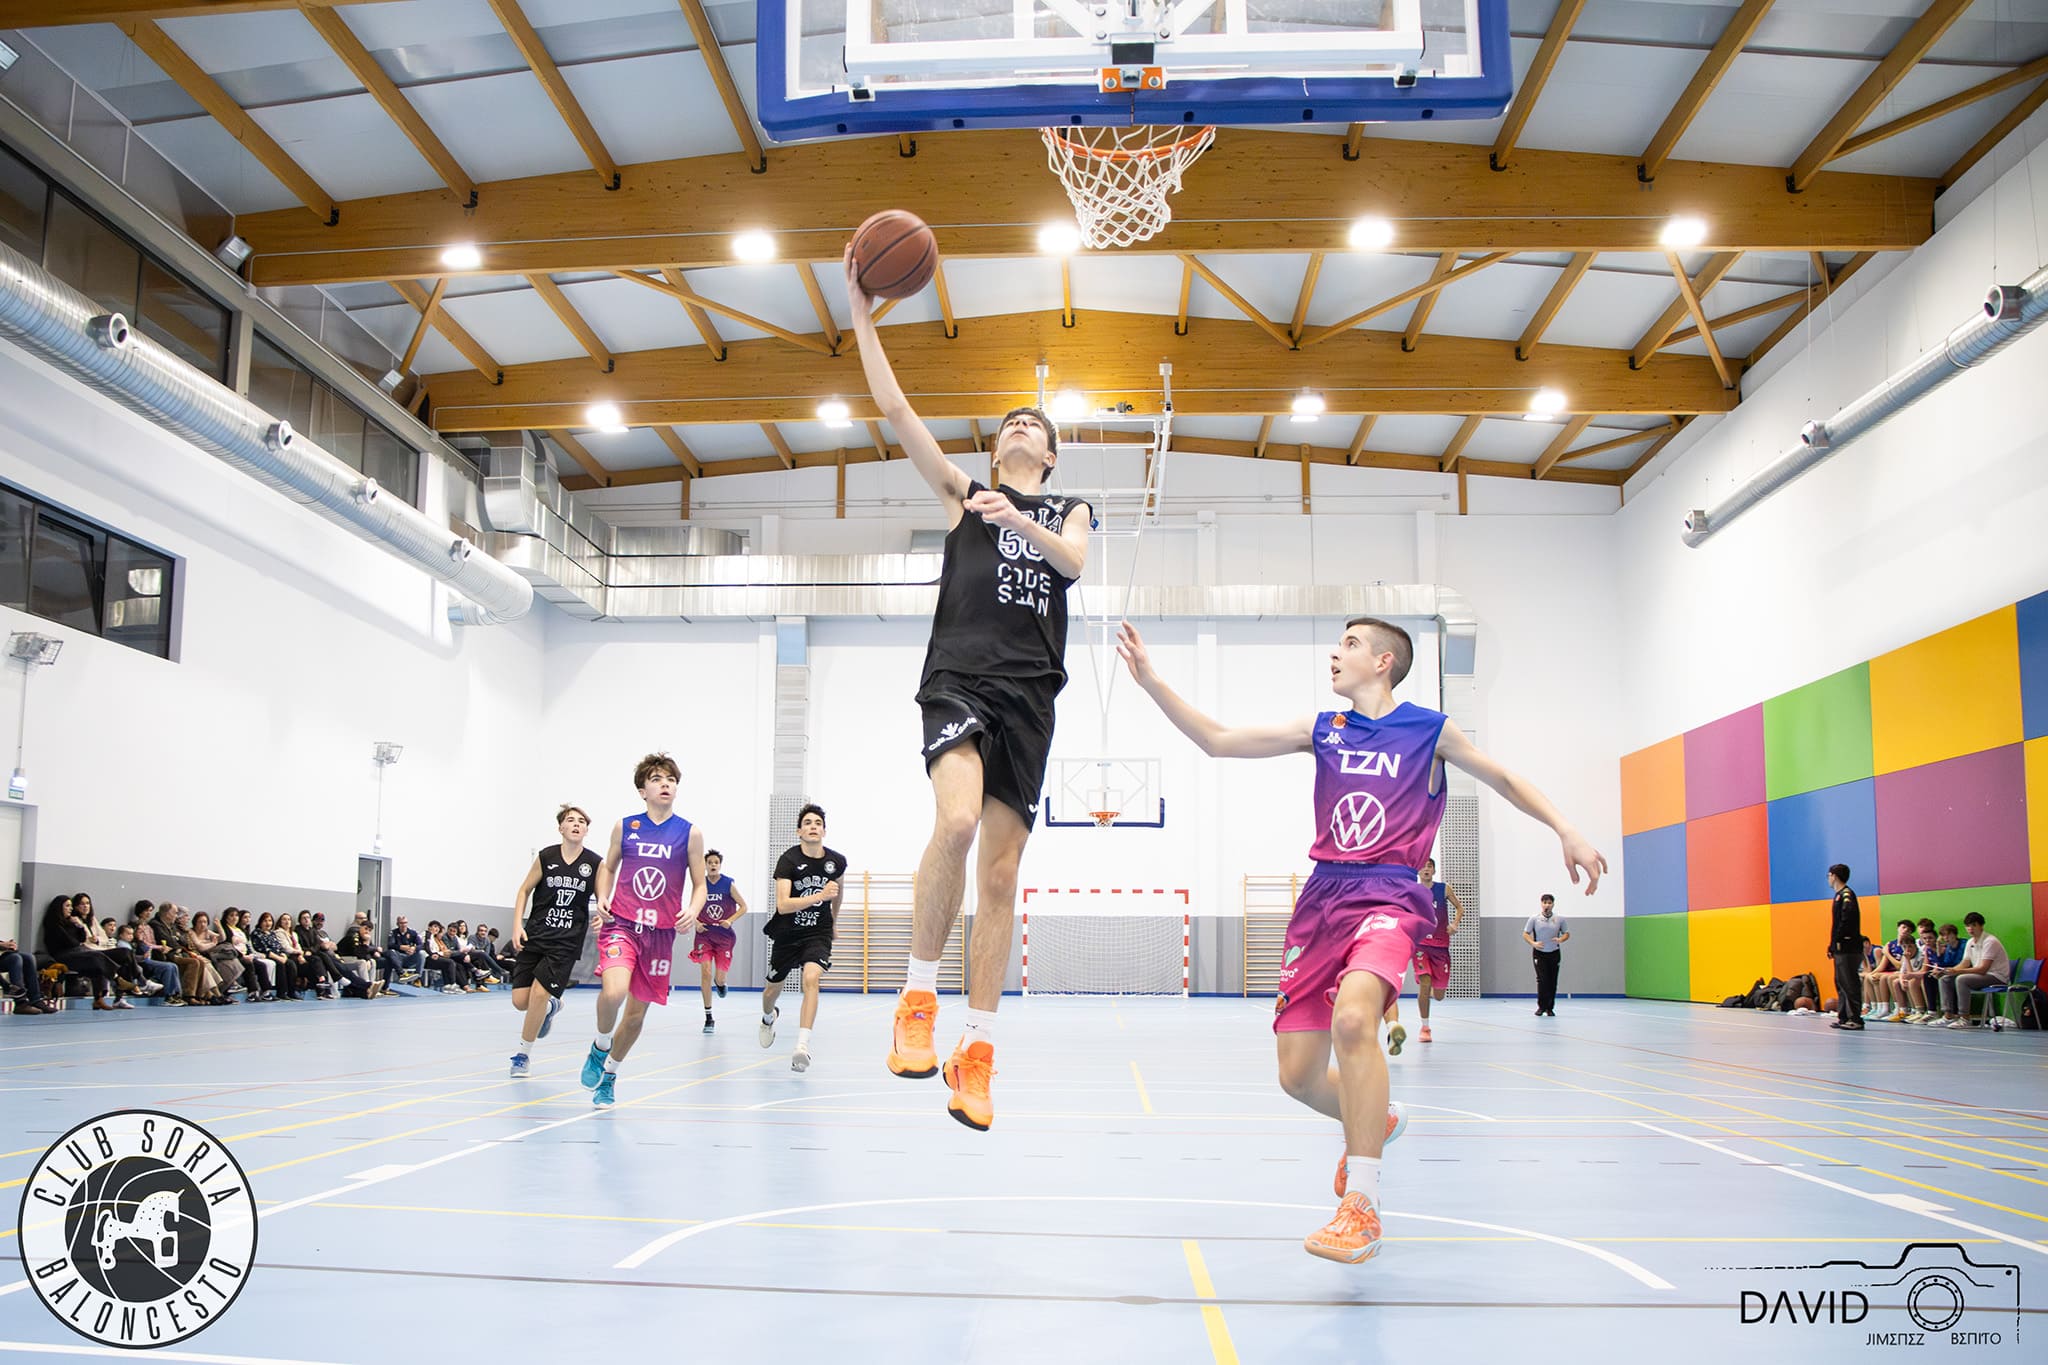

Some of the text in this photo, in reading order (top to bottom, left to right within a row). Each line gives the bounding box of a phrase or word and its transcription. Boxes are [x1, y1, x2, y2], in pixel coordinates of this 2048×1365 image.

[1337, 748, 1401, 778] TZN
[636, 842, 672, 860] TZN
[546, 876, 587, 892] SORIA
[556, 889, 577, 906] 17
[635, 908, 658, 926] 19
[649, 959, 672, 976] 19
